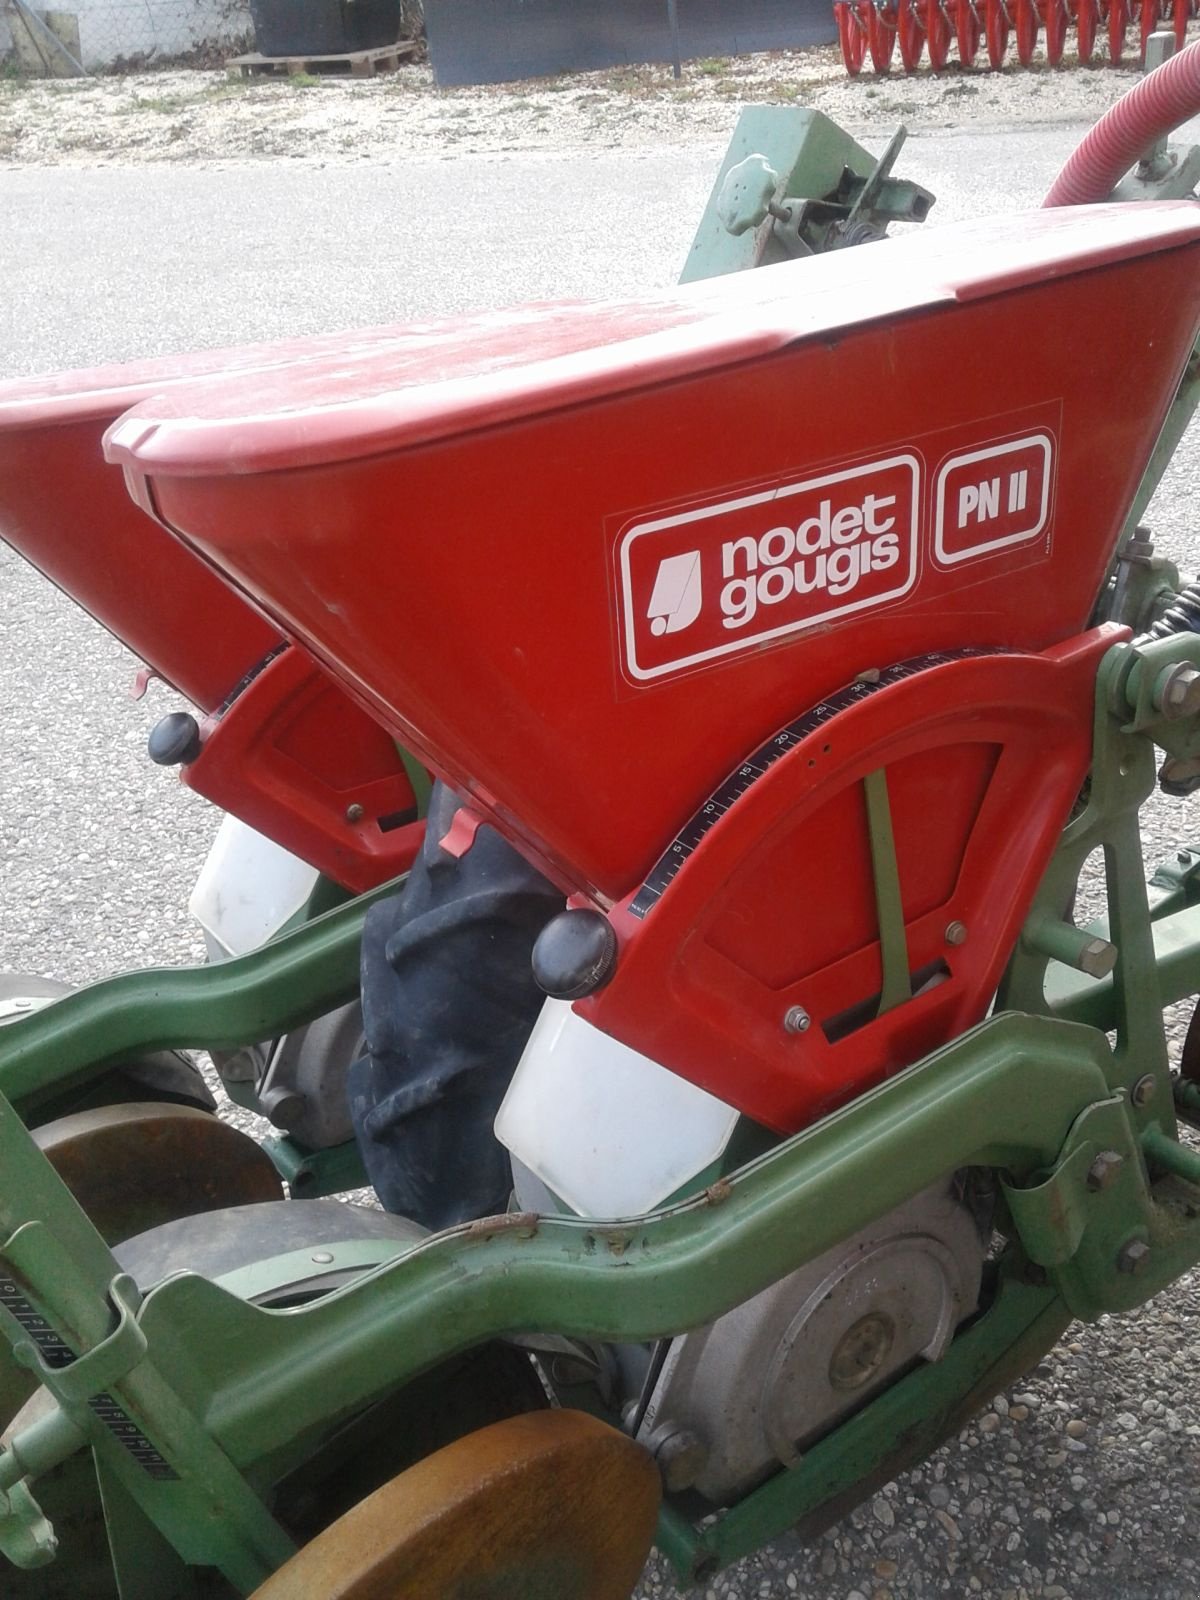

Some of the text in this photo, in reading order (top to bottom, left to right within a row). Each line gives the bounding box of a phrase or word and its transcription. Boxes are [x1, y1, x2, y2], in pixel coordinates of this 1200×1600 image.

[958, 477, 1000, 528] PN
[722, 494, 896, 578] nodet
[720, 533, 899, 629] gougis
[851, 682, 866, 693] 30
[812, 705, 827, 716] 25
[774, 733, 789, 745] 20
[739, 766, 752, 777] 15
[703, 803, 715, 815] 10
[672, 844, 682, 853] 5
